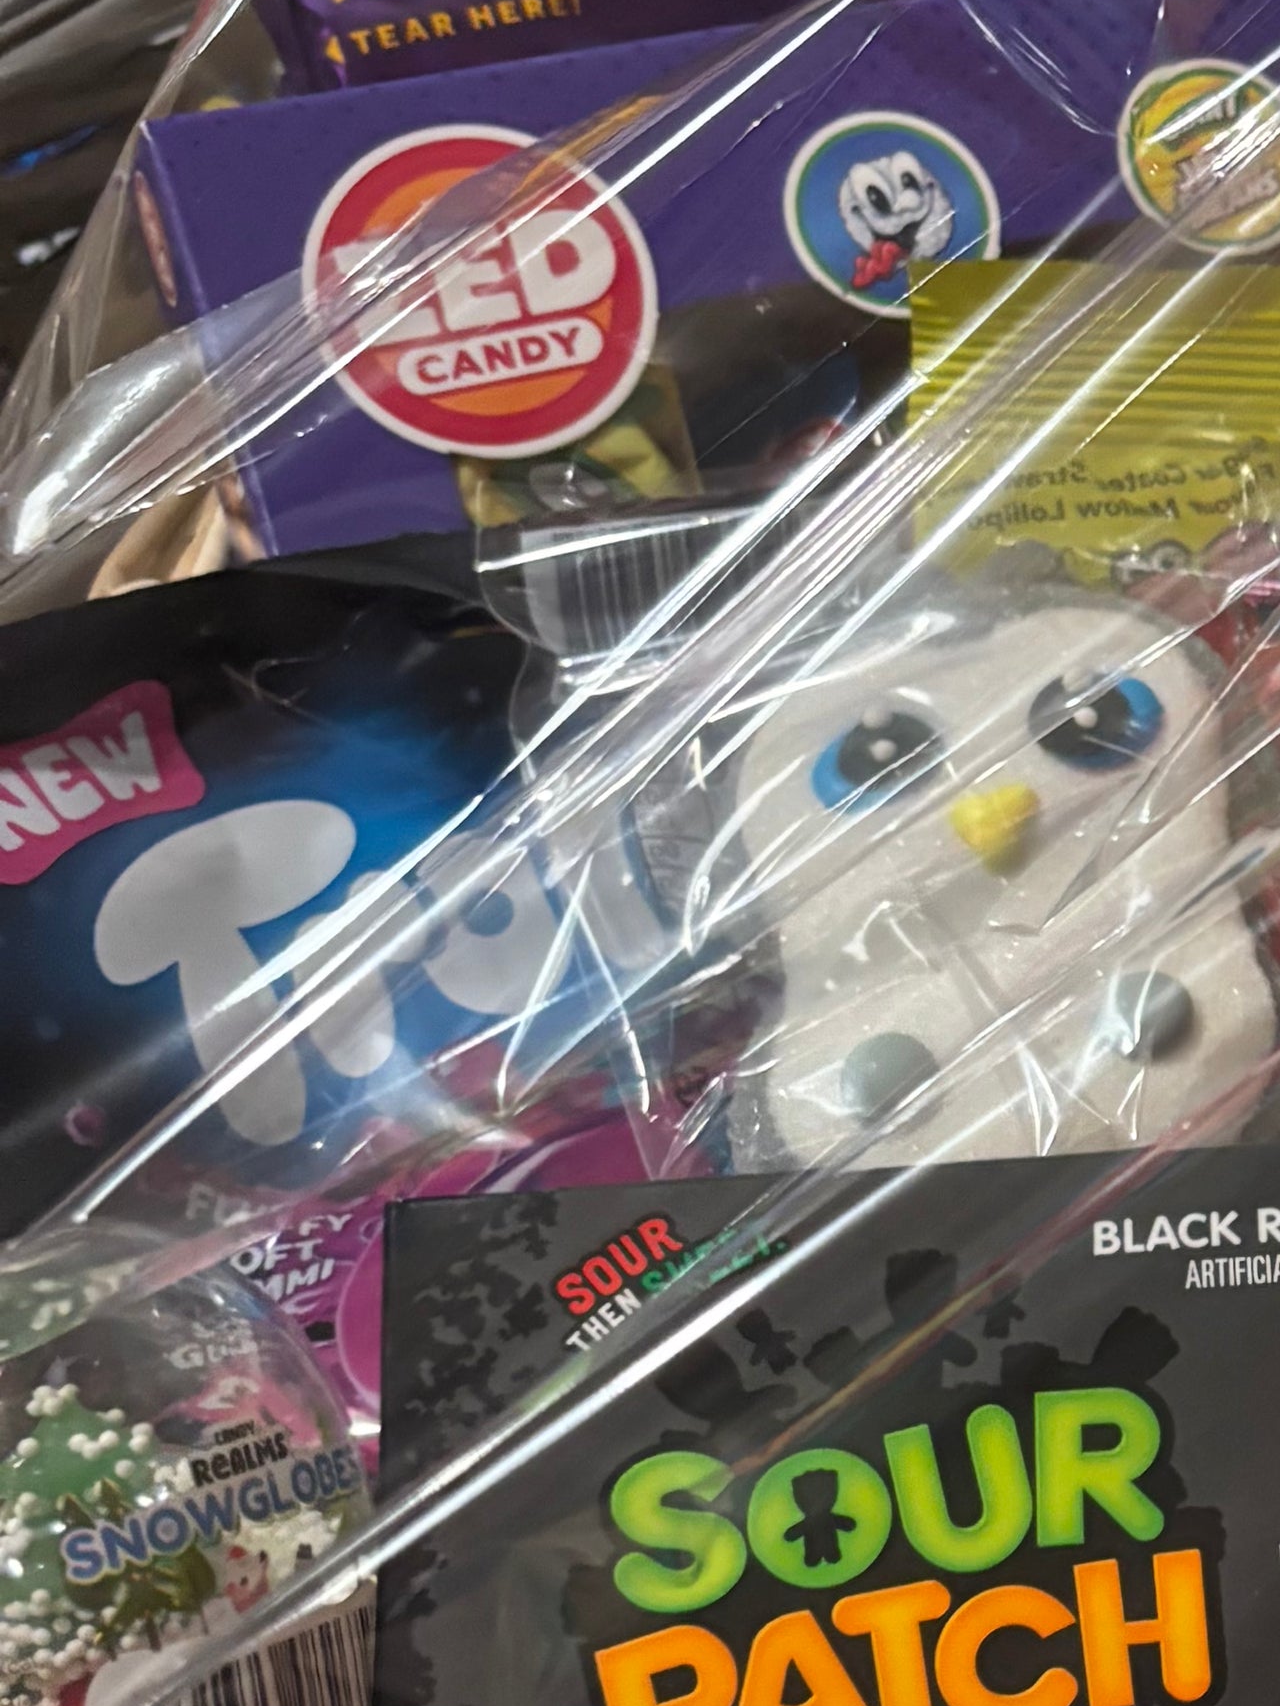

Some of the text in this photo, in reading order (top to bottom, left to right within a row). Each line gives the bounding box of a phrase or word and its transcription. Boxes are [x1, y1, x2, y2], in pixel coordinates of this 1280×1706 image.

[349, 11, 457, 55] TEAR
[413, 325, 583, 385] CANDY
[0, 711, 163, 853] NEW
[229, 1238, 324, 1276] OFT
[1093, 1210, 1242, 1257] BLACK
[556, 1217, 684, 1316] SOUR
[566, 1288, 643, 1352] THEN
[611, 1385, 1165, 1615] SOUR
